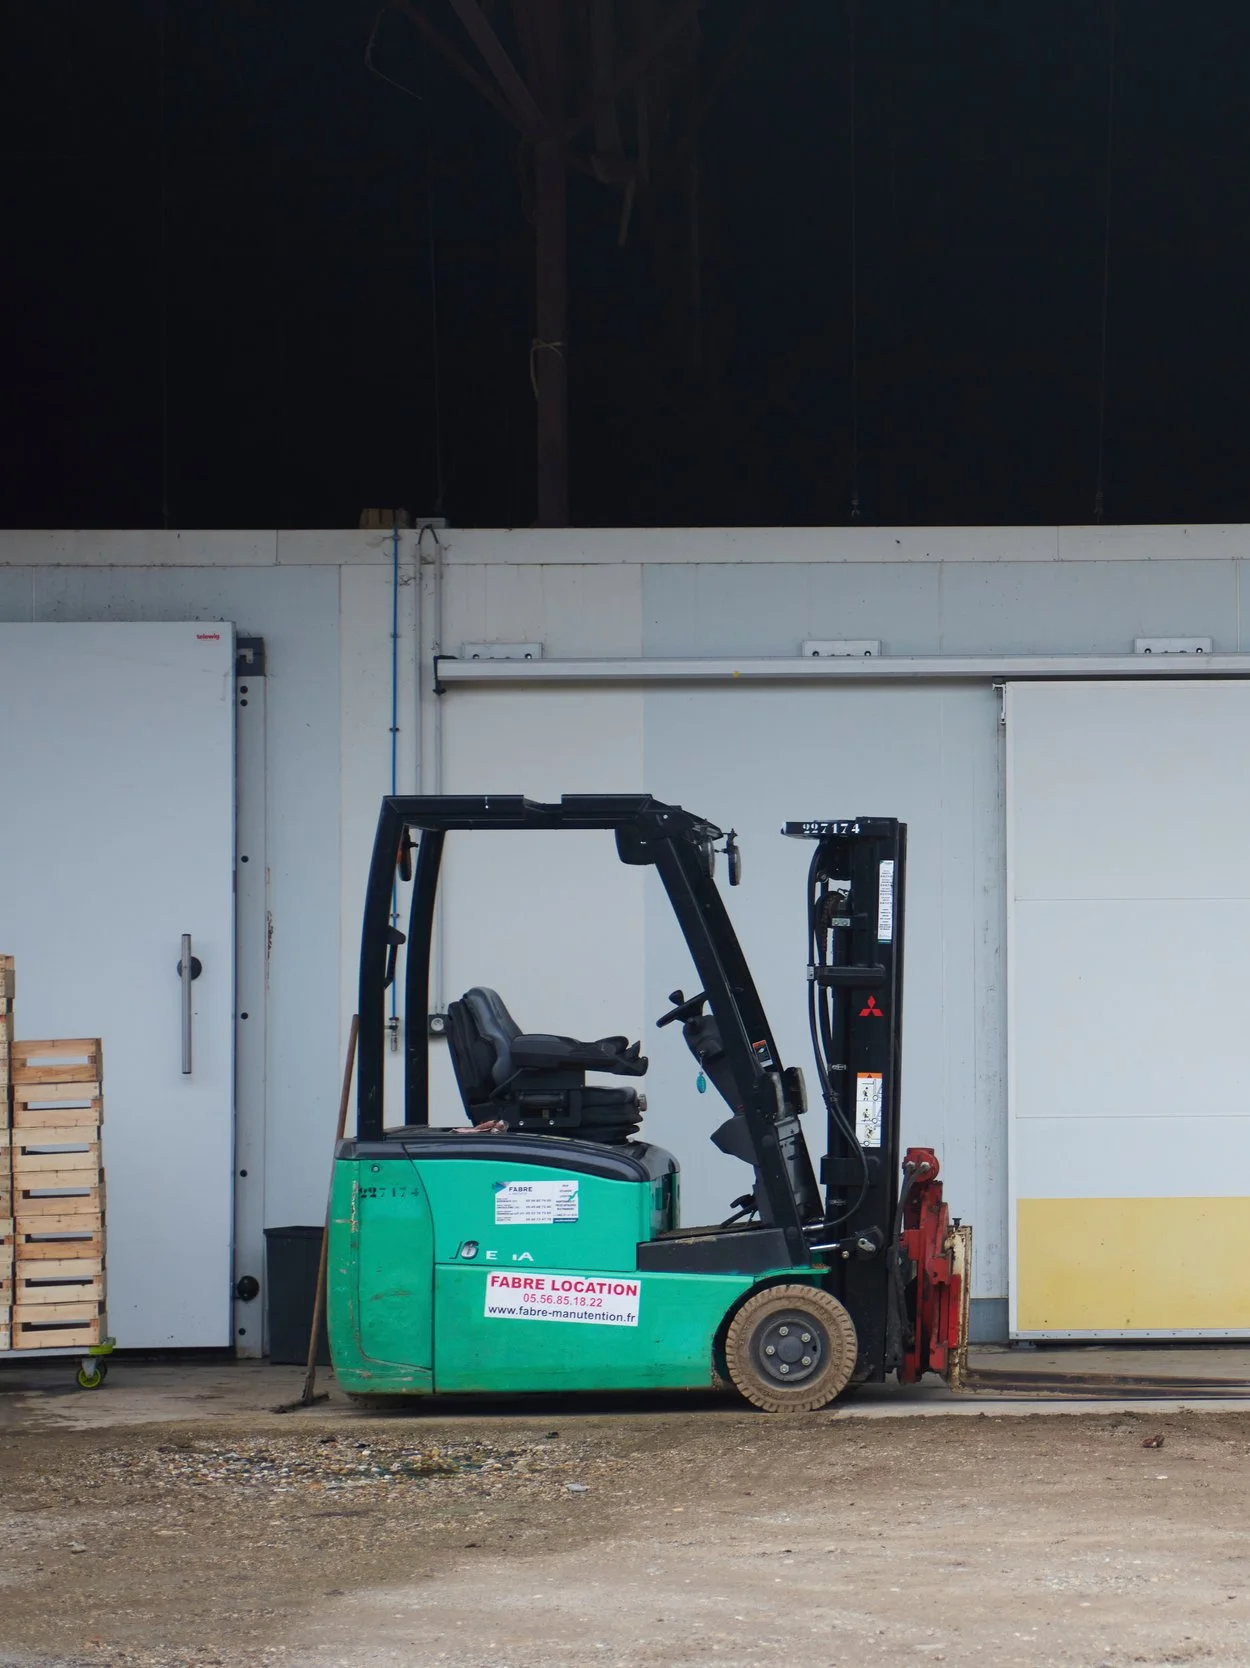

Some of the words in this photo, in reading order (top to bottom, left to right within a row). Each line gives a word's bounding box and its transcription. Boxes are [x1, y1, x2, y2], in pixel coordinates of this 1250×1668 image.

[802, 823, 860, 834] 227174
[490, 1275, 545, 1290] FABRE
[551, 1279, 637, 1296] LOCATION
[523, 1293, 603, 1308] 05.56.85.18.22
[488, 1305, 635, 1323] www.fabre-manutention.fr
